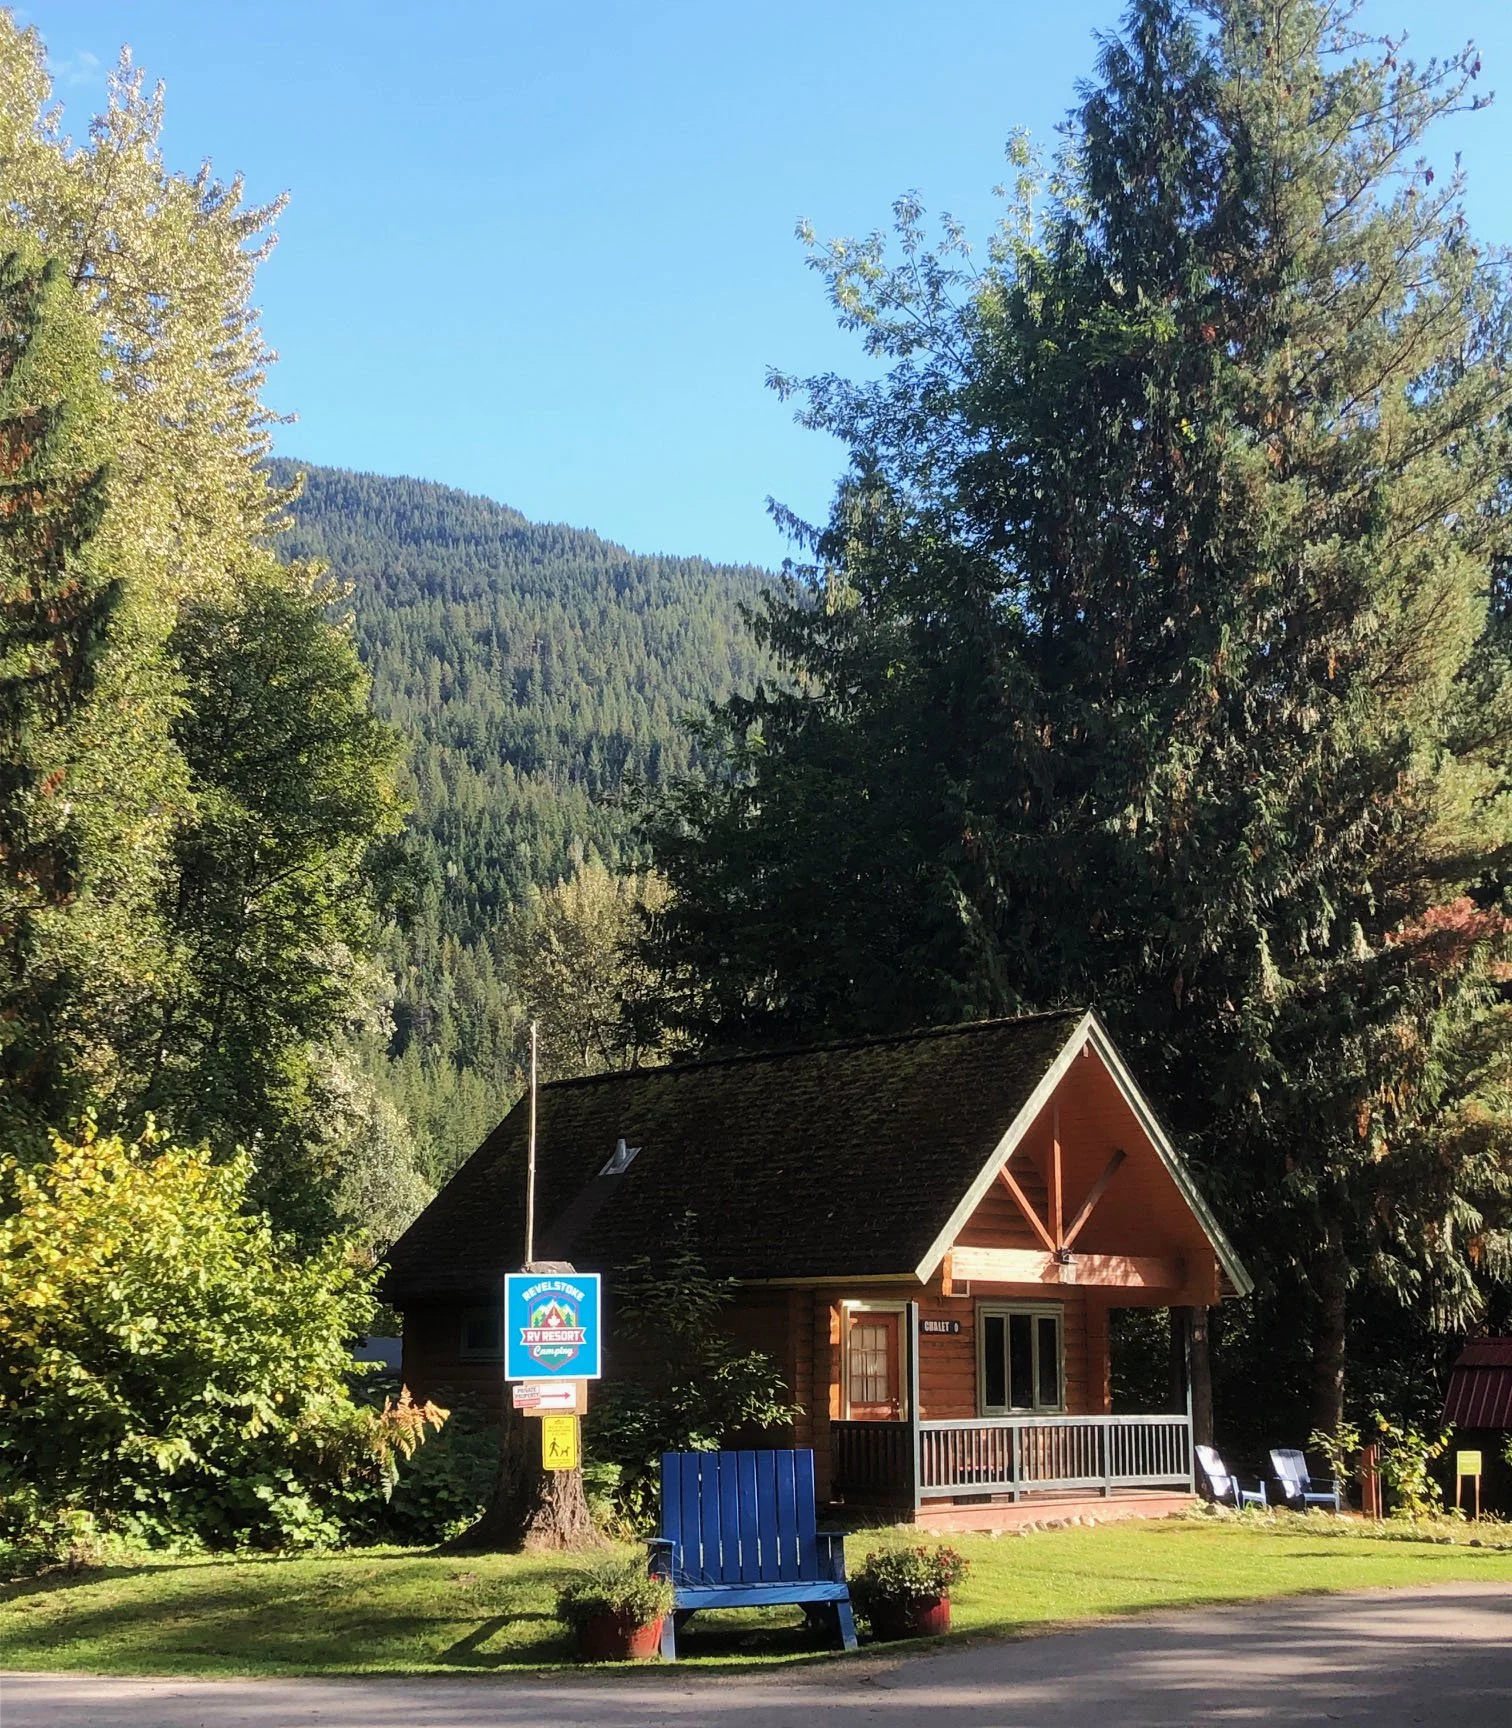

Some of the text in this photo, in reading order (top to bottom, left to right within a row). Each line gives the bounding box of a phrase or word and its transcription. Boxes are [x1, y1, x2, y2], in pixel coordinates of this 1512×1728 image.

[521, 1281, 585, 1302] REVELSTOKE
[924, 1321, 949, 1332] CHALET
[526, 1330, 580, 1342] RV RESORT
[533, 1345, 574, 1357] Camping
